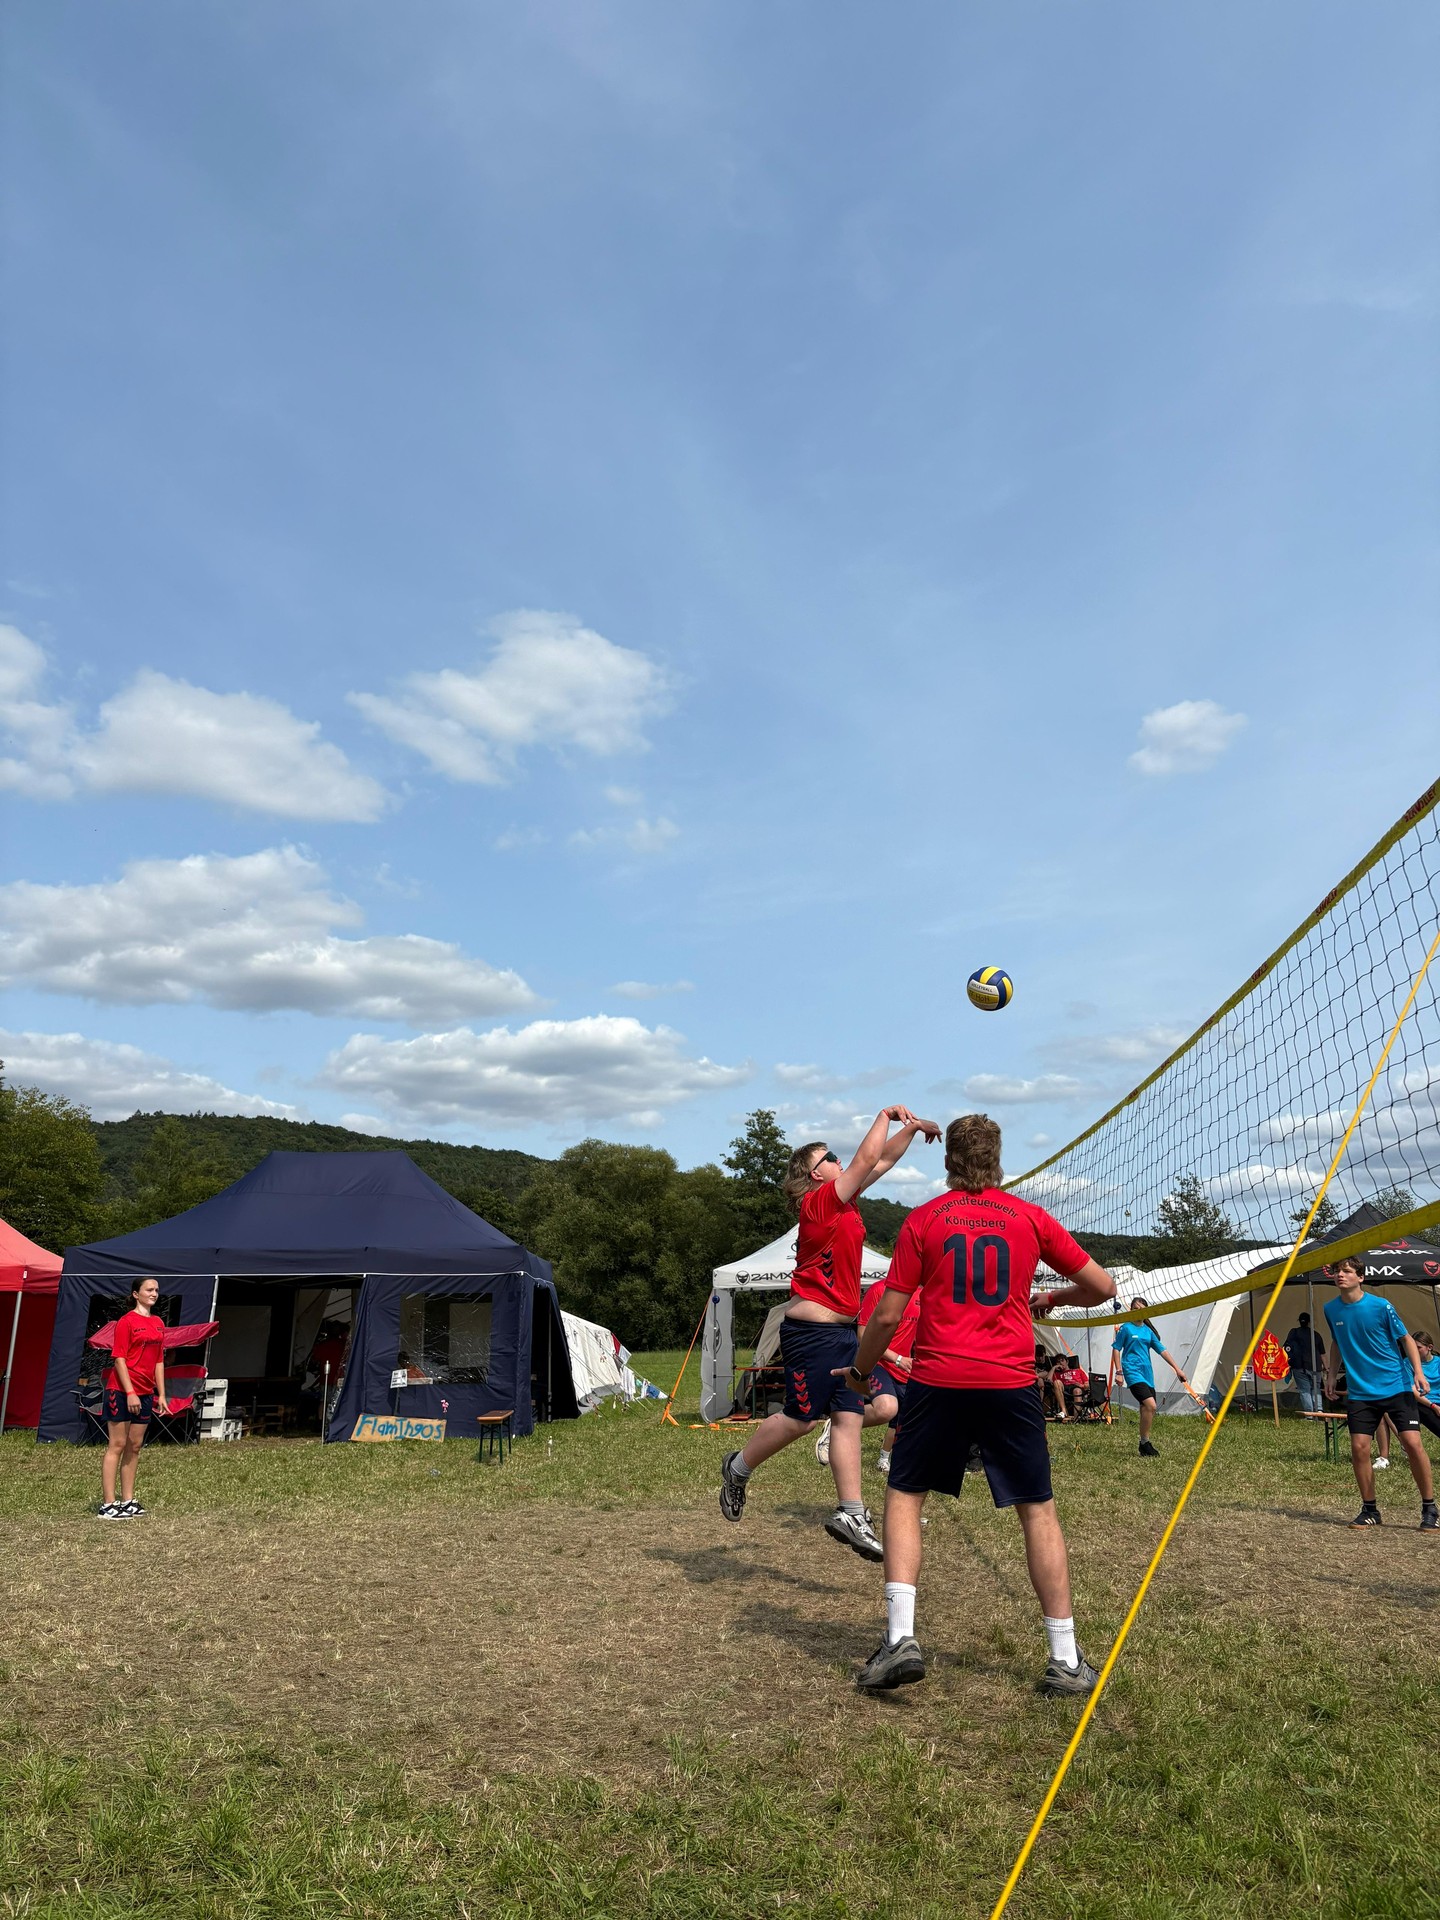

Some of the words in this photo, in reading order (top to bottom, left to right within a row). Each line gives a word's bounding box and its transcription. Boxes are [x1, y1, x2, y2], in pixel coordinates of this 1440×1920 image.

[932, 1196, 1019, 1219] Jugendfeuerwehr
[945, 1215, 1006, 1230] Königsberg
[750, 1272, 793, 1282] 24MX
[943, 1233, 1010, 1307] 10
[1045, 1274, 1069, 1283] 24
